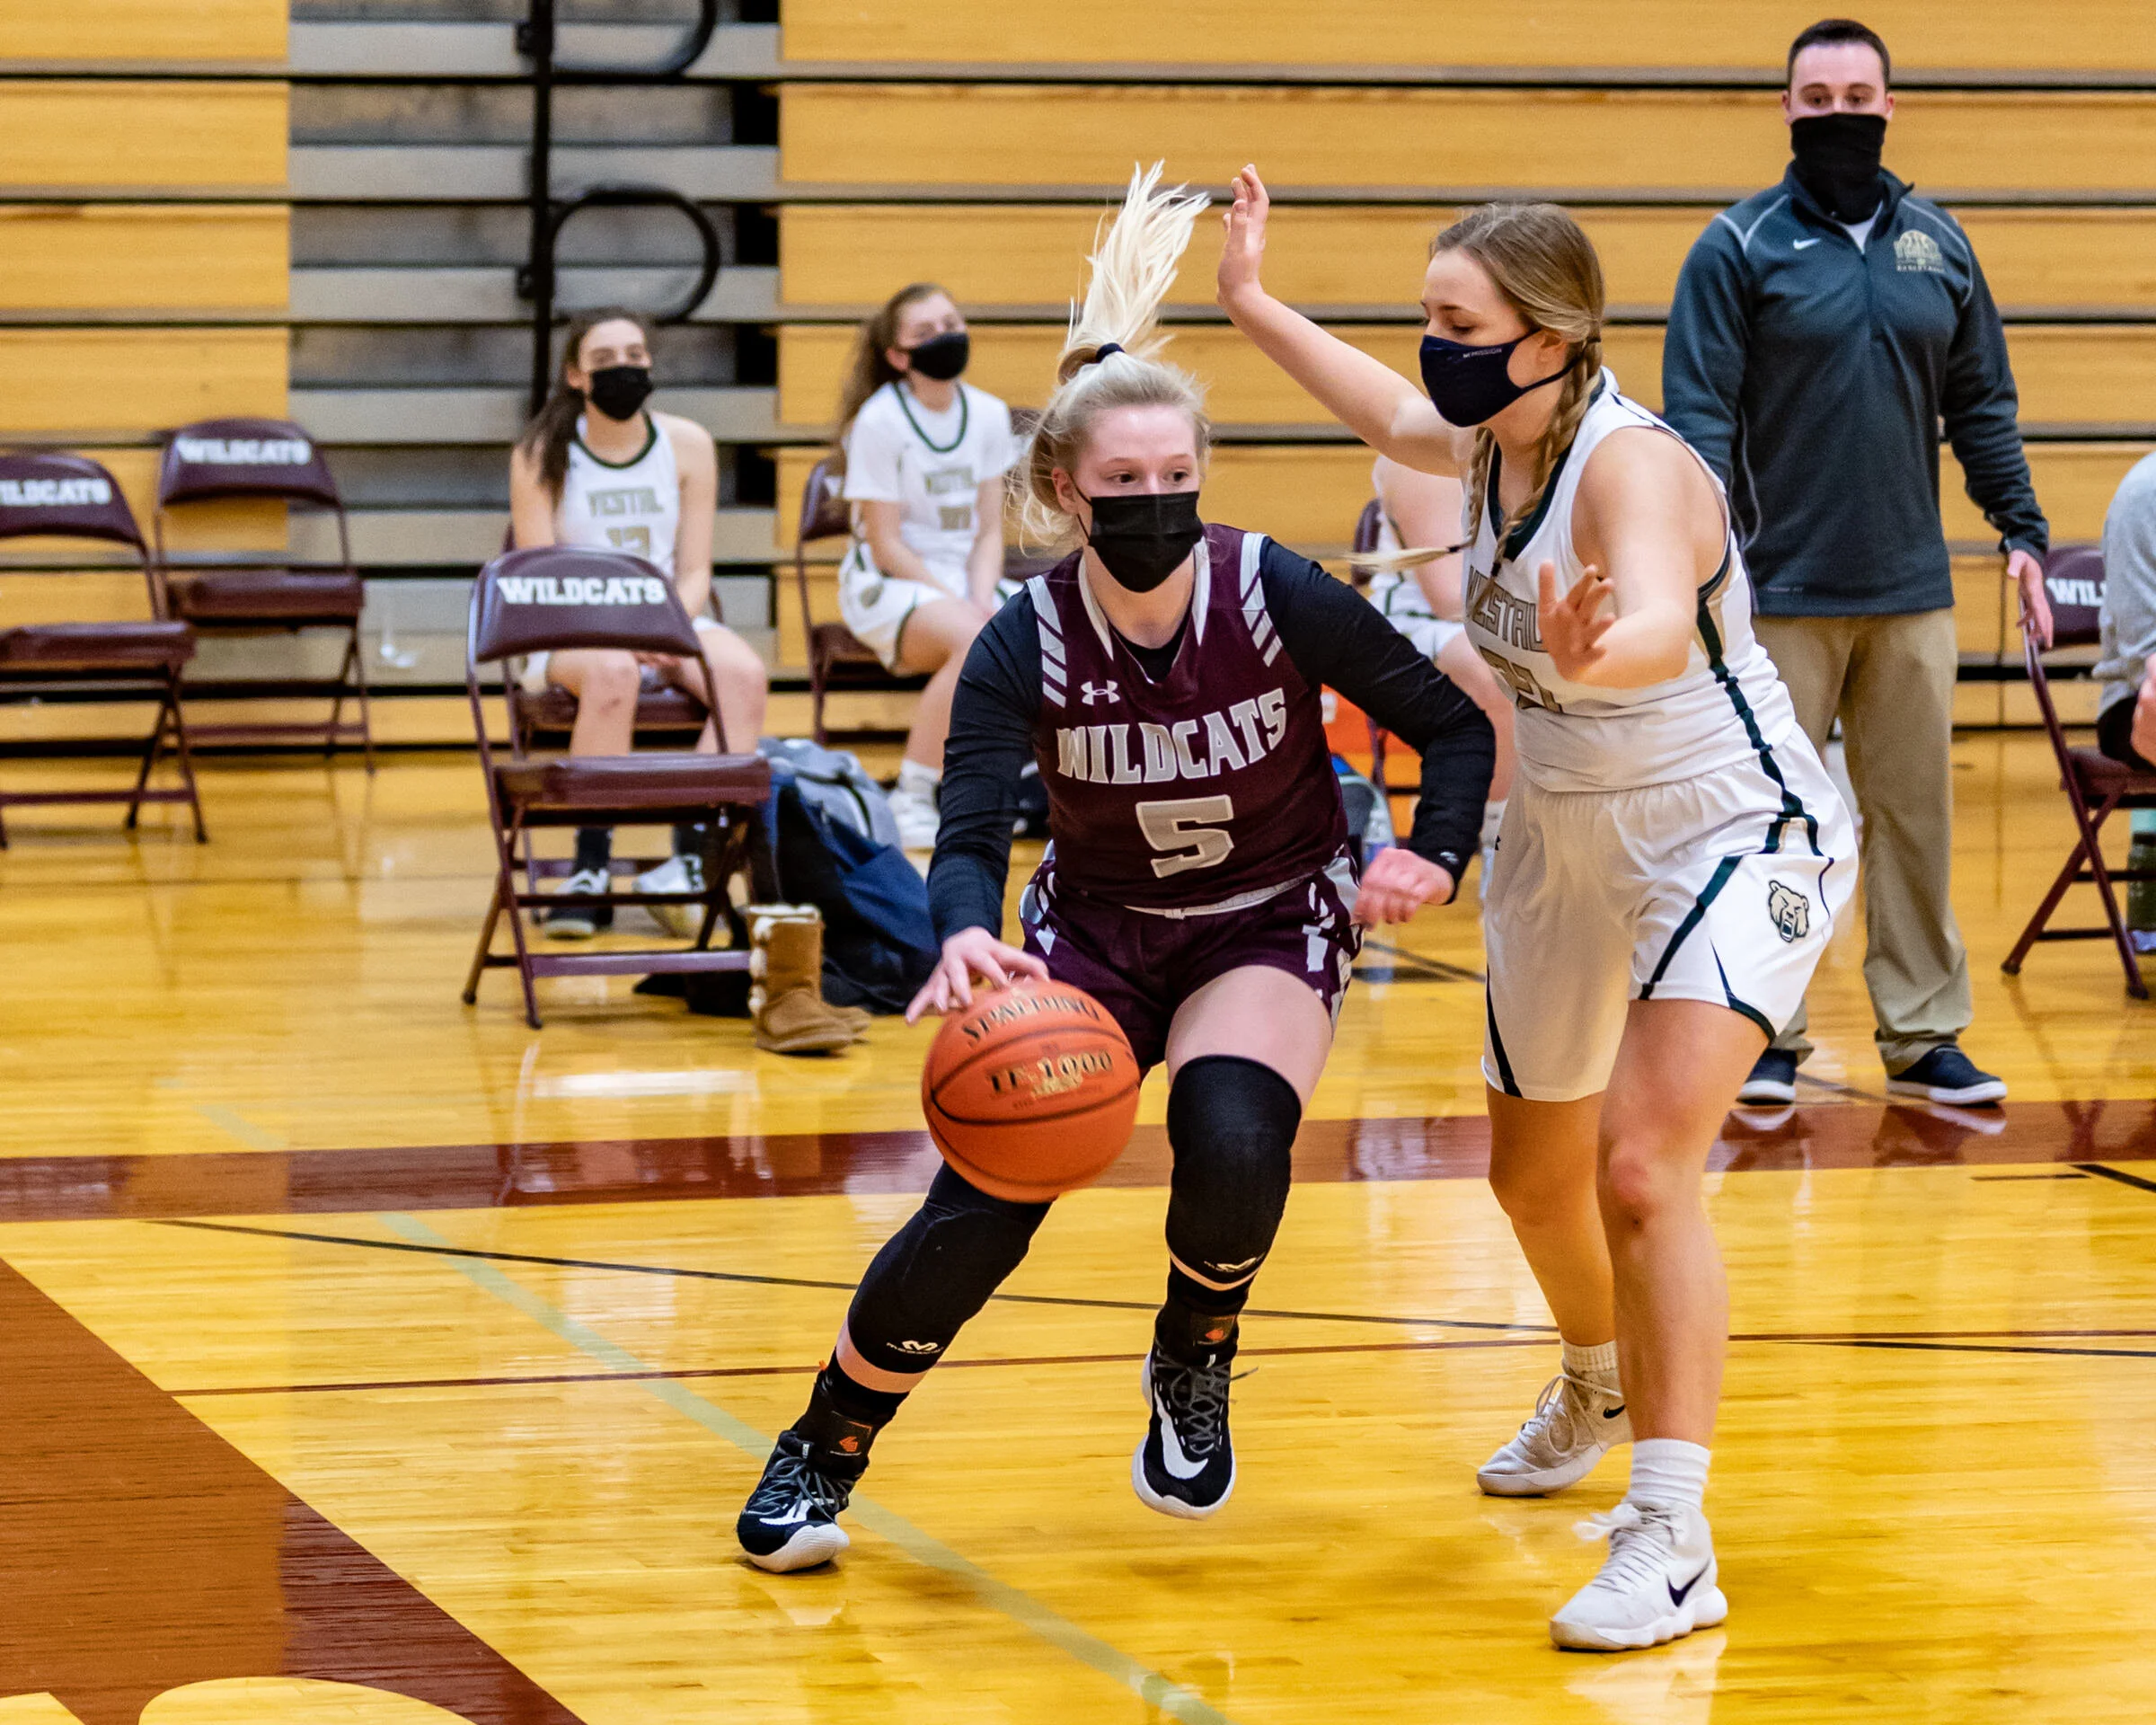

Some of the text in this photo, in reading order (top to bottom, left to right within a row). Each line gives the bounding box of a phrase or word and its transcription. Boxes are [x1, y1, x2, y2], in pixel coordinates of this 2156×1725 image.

[177, 438, 312, 465] WILDCATS
[0, 478, 112, 506] ILDCATS
[497, 576, 667, 606] WILDCATS
[2046, 577, 2107, 606] WIL
[1056, 686, 1287, 784] WILDCATS
[1135, 793, 1235, 879] 5
